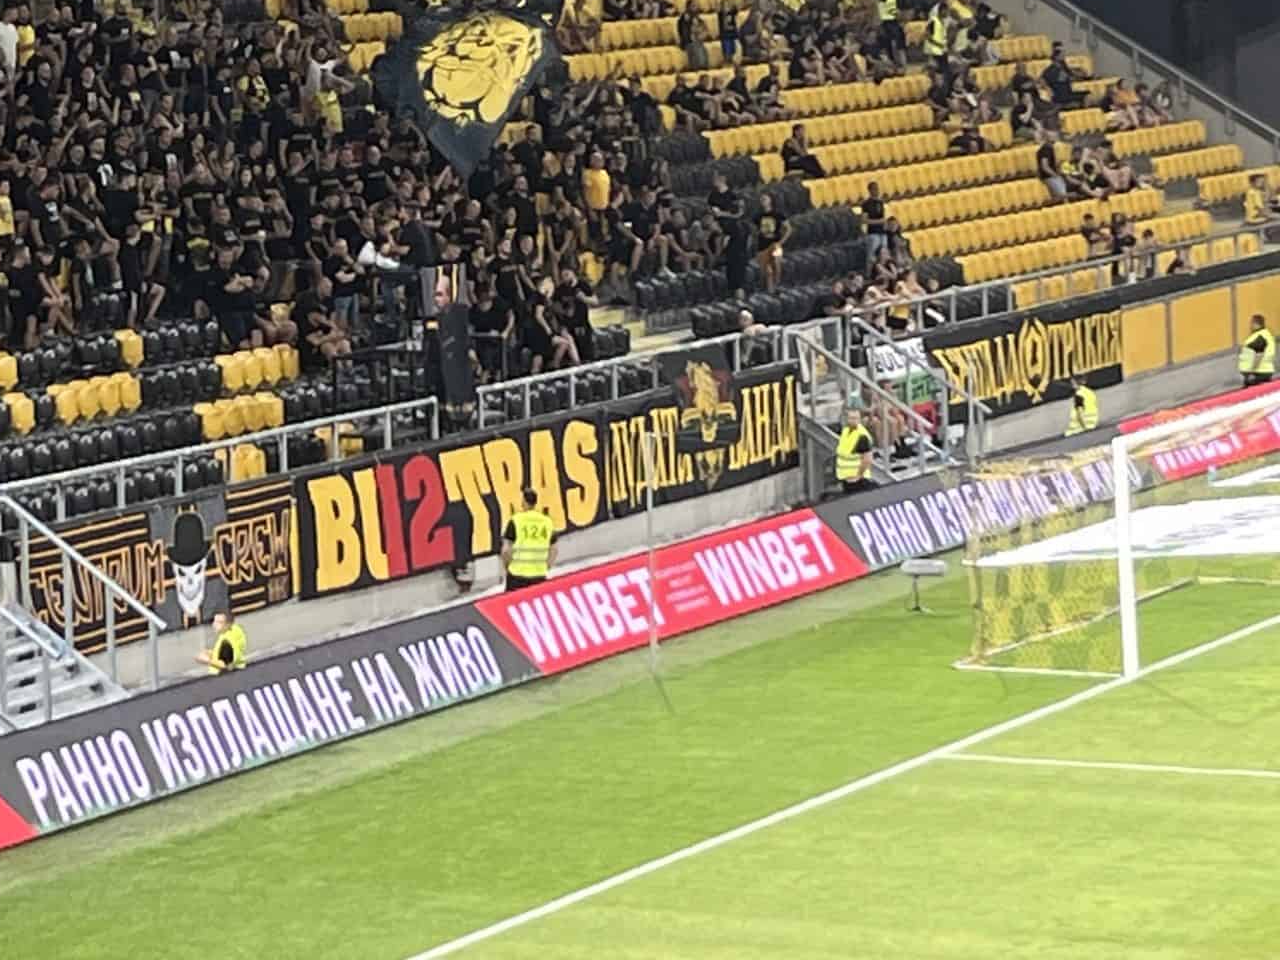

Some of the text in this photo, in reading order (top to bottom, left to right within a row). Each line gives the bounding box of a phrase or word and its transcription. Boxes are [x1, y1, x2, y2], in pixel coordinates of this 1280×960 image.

[215, 508, 290, 585] CREW
[521, 525, 547, 540] 124
[694, 517, 836, 607] WINBET
[849, 500, 935, 565] РАННО
[508, 567, 664, 663] WINBET
[16, 625, 503, 828] РАННО ИЗПЛАЩАНЕ НА ЖИВО
